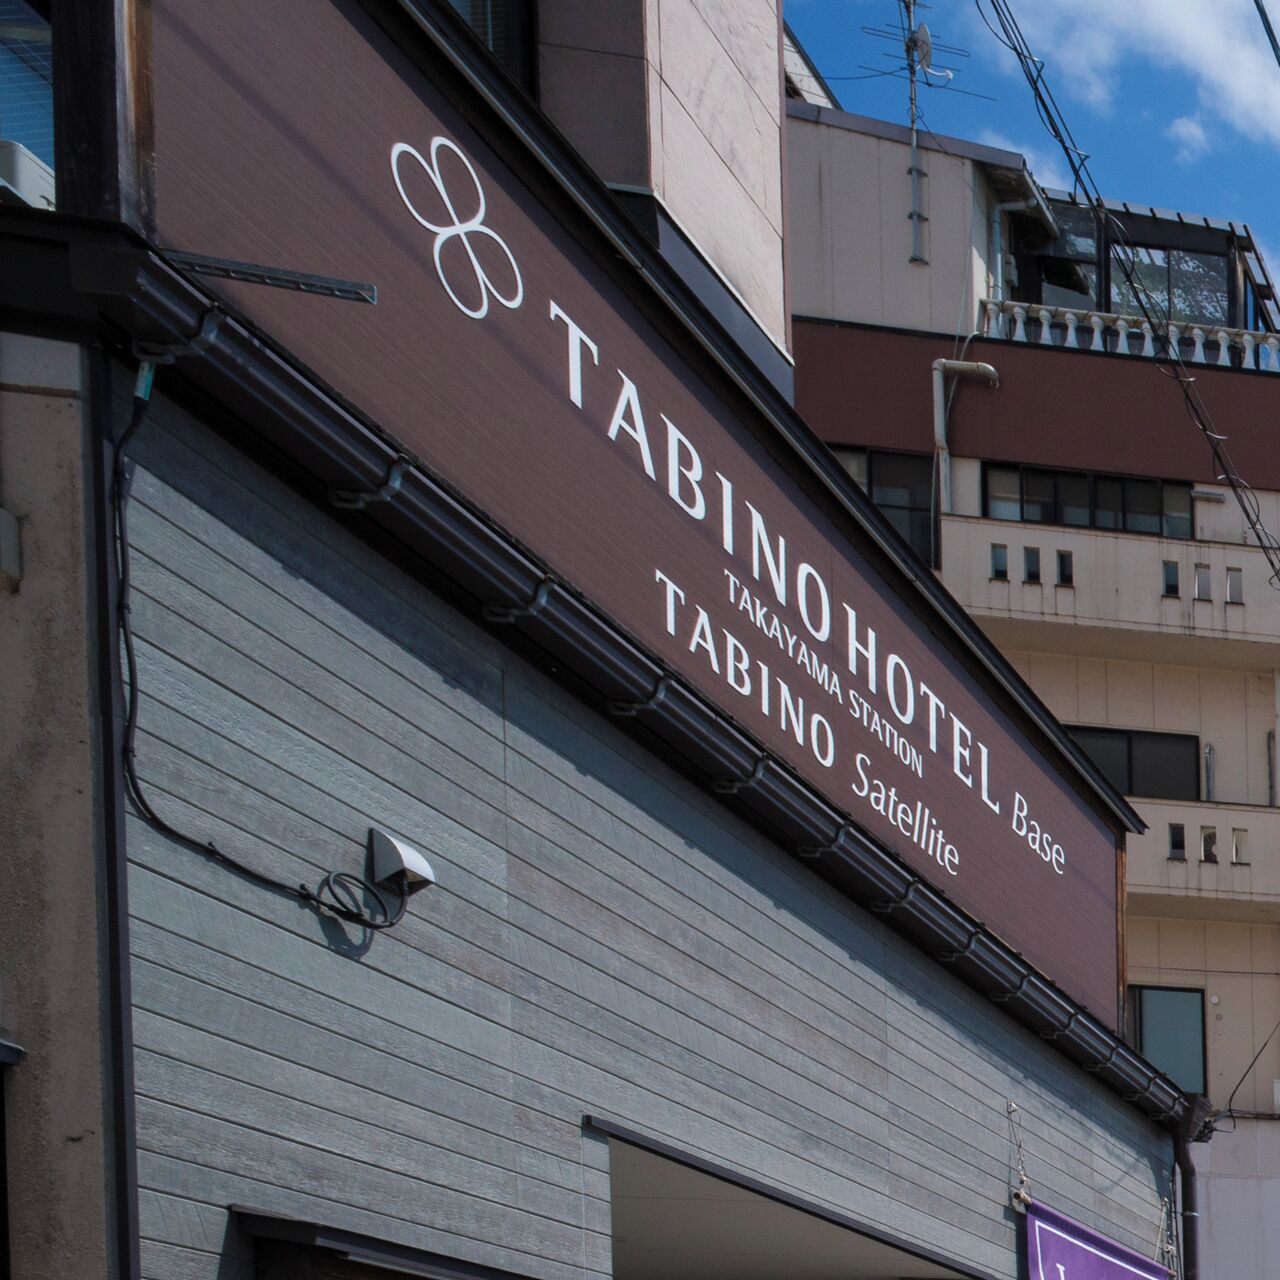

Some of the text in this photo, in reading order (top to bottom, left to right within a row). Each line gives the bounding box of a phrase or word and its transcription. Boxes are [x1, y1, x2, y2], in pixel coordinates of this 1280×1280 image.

[549, 300, 1065, 875] TABINO HOTEL Base
[655, 569, 960, 876] TABINO Satellite
[724, 568, 924, 778] TAKAYAMA STATION
